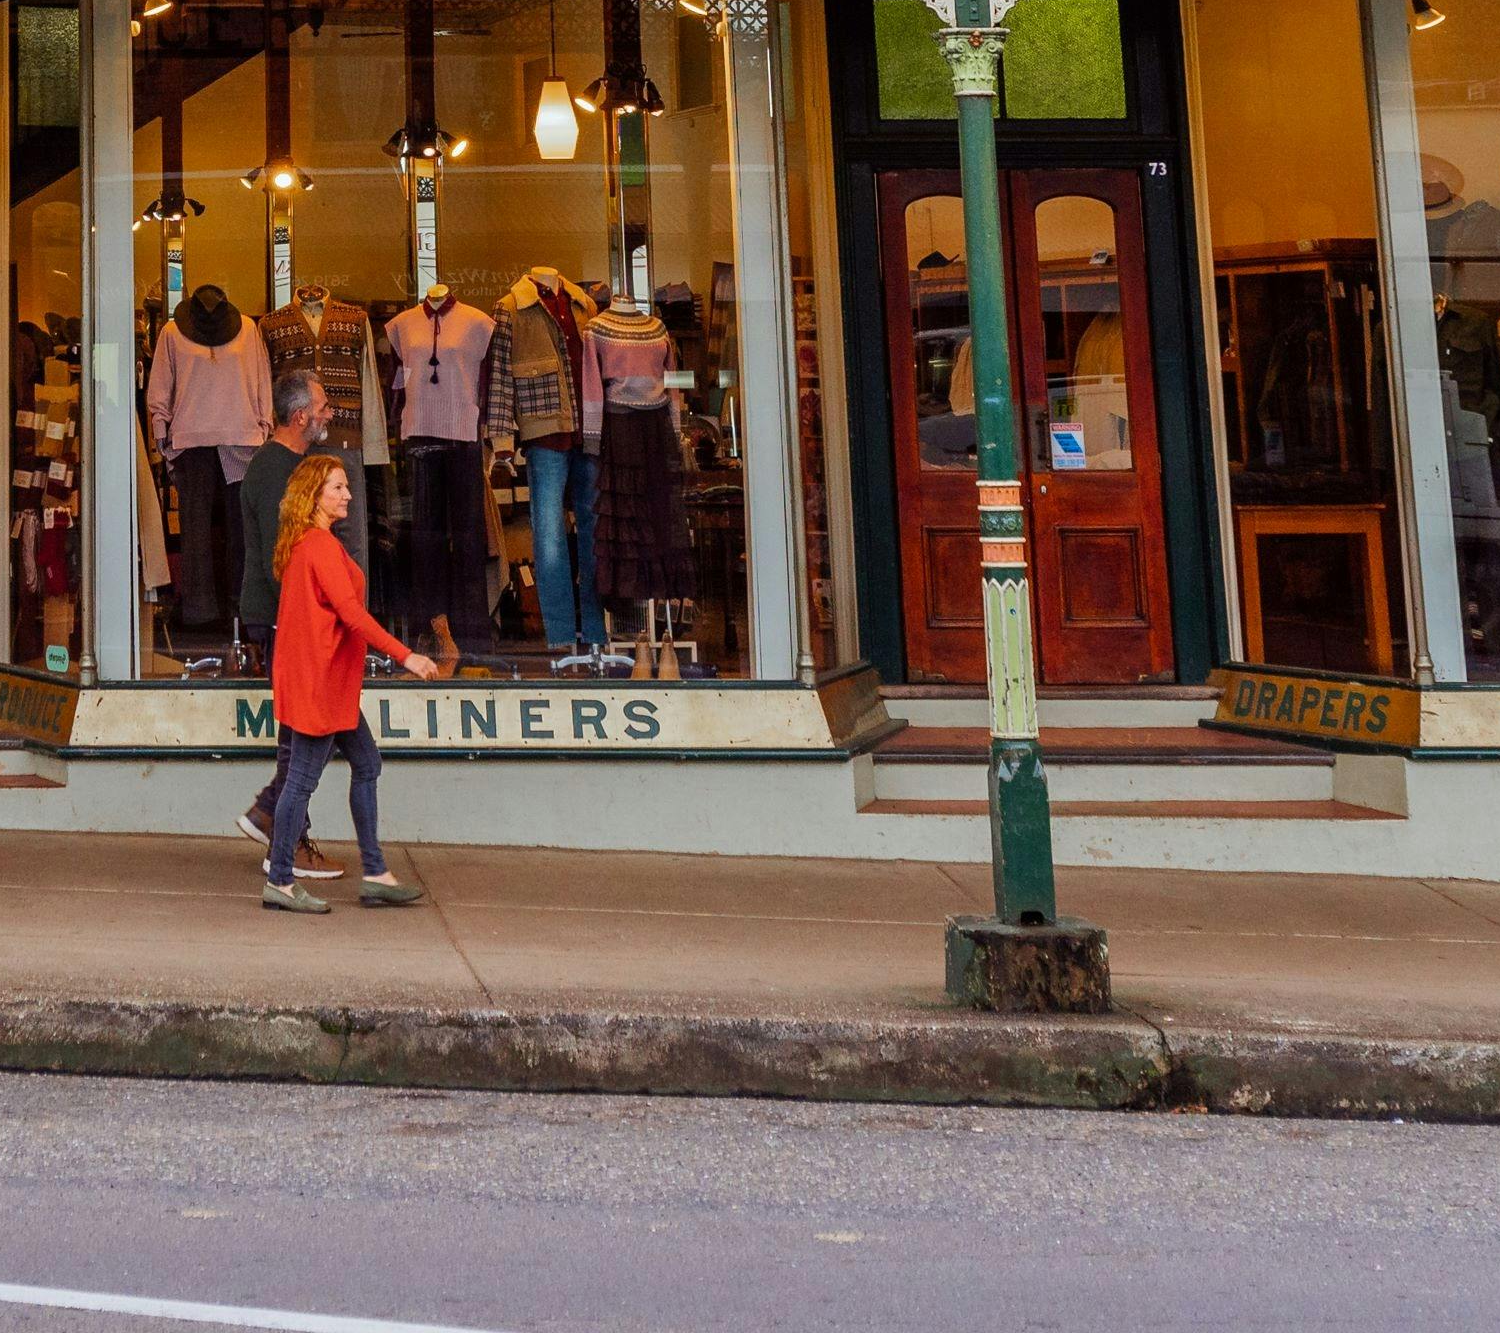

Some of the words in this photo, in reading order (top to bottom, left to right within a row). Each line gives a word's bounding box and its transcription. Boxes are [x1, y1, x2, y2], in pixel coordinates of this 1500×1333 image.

[1149, 162, 1167, 176] 73
[235, 698, 661, 739] MLINERS
[1233, 679, 1391, 734] DRAPERS
